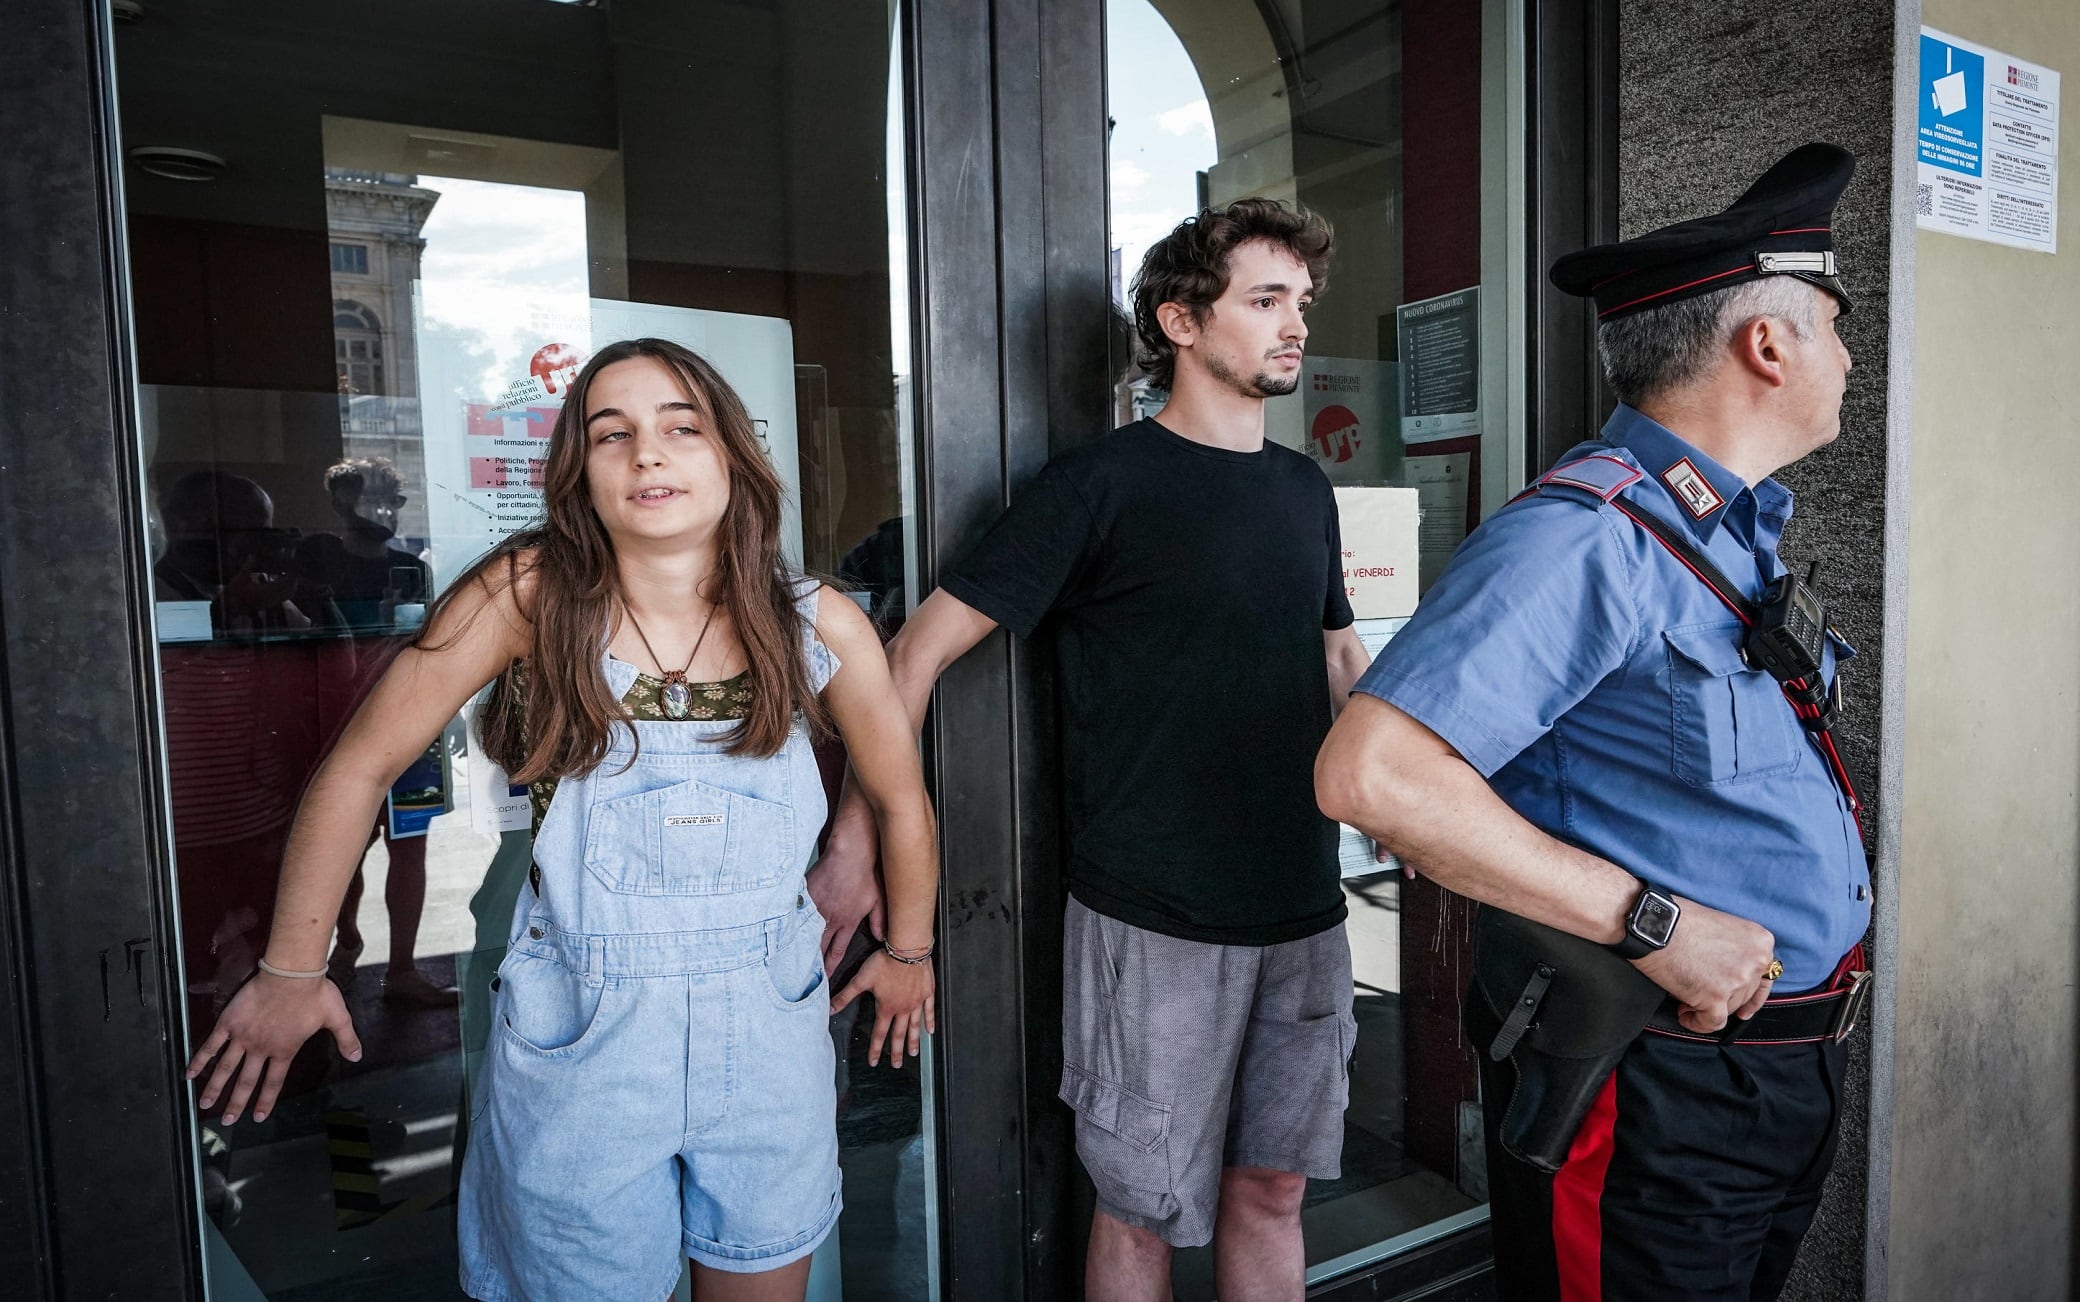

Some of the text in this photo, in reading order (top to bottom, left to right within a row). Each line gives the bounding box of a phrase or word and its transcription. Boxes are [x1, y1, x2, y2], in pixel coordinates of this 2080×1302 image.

[2018, 69, 2039, 83] REGIONE
[2018, 79, 2038, 92] PIEMONTE
[1997, 90, 2014, 100] TITOLARE
[2022, 98, 2048, 110] TRATTAMENTO
[1935, 123, 1964, 137] ATTENZIONE
[2012, 121, 2032, 130] CONTATTO
[1920, 128, 1978, 149] AREA VIDEOSORVEGLIATA
[1919, 140, 1935, 150] TEMPO
[1942, 146, 1978, 162] CONSERVAZIONE
[1922, 149, 1936, 158] DELLE
[1966, 160, 1975, 169] ORE
[2021, 160, 2046, 170] TRATTAMENTO
[1404, 296, 1464, 318] NUOVO CORONAVIRUS
[508, 378, 535, 390] ufficio
[1328, 384, 1360, 392] PIEMONTE
[503, 384, 538, 400] relazioni
[506, 393, 541, 409] pubblico
[1353, 568, 1395, 577] VENERDI
